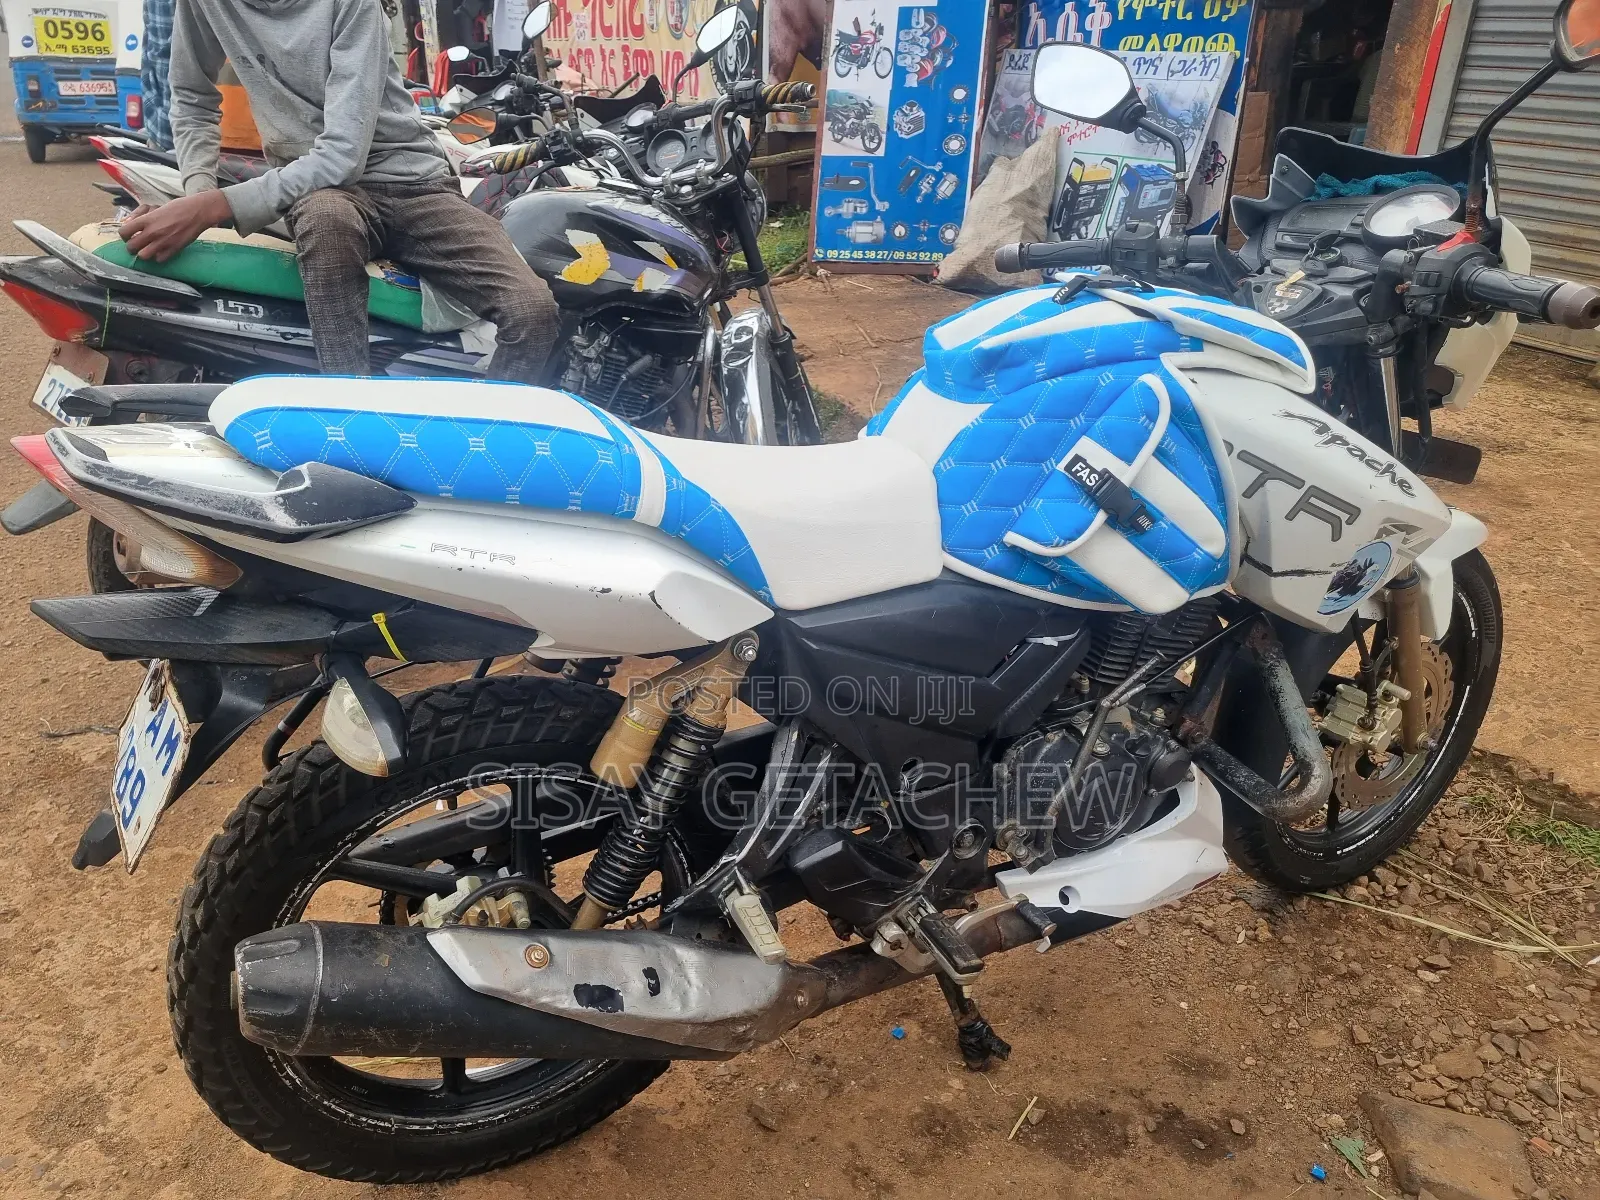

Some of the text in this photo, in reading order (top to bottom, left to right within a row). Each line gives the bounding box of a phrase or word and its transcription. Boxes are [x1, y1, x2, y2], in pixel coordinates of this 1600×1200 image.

[43, 19, 105, 41] 0596
[71, 45, 110, 55] 63695
[826, 249, 838, 259] 09
[839, 250, 851, 259] 25
[851, 250, 864, 259] 45
[864, 251, 876, 260] 38
[906, 252, 917, 260] 52
[918, 252, 930, 261] 92
[931, 252, 944, 261] 89
[1272, 408, 1416, 498] Apache
[1221, 438, 1362, 542] TR
[430, 542, 516, 566] RTR
